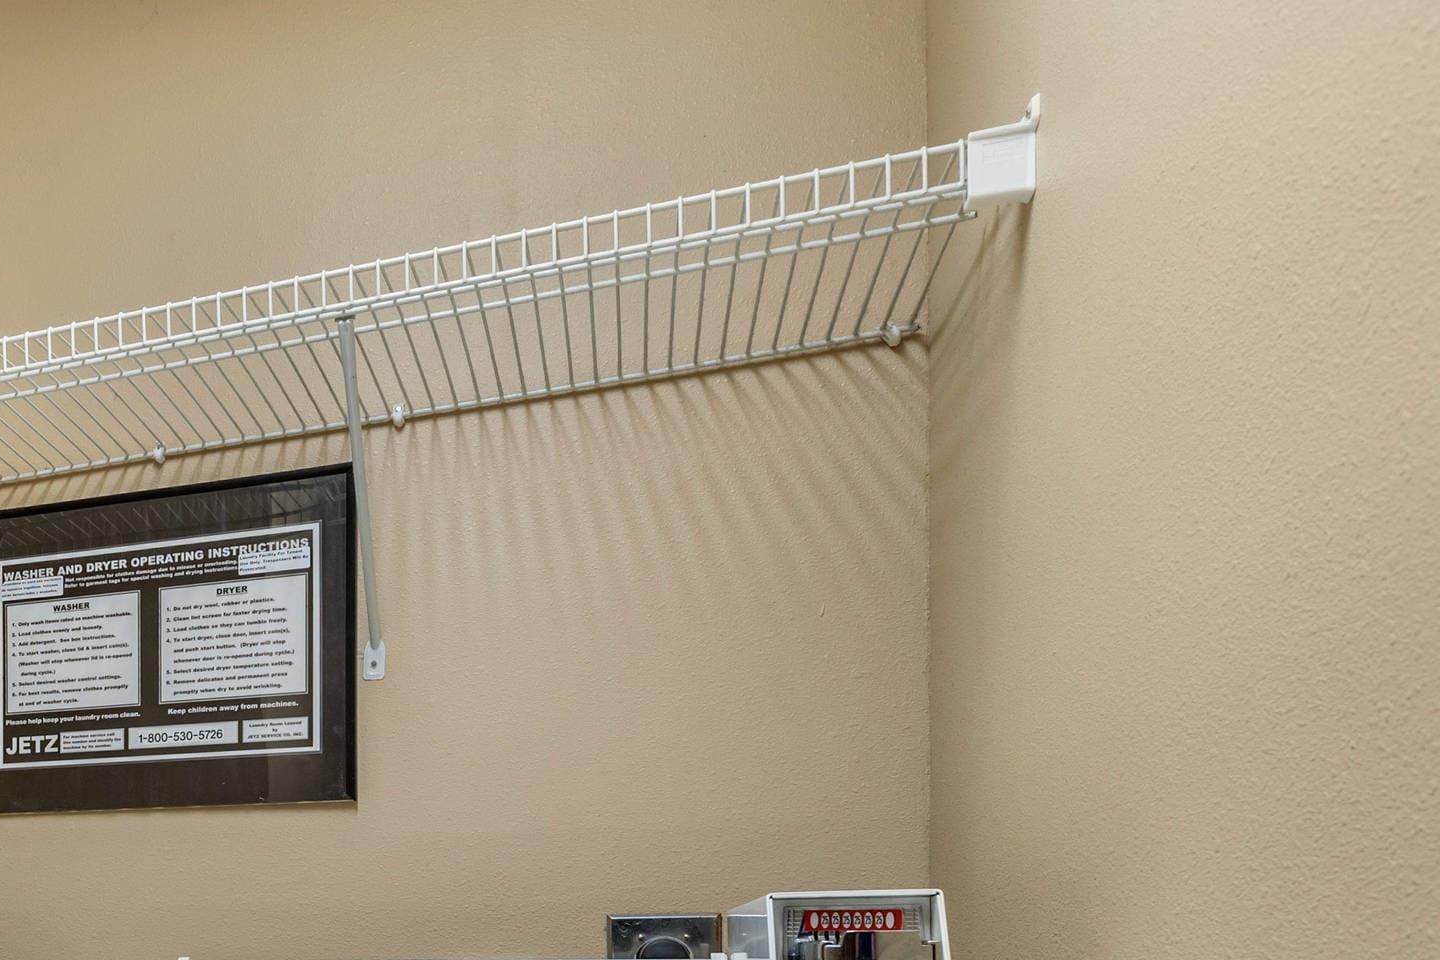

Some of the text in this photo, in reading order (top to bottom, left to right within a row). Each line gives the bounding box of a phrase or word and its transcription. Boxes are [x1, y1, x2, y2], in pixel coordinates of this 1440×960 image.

[3, 537, 309, 582] WASHER AND DRYER OPERATING INSTRUCTIONS
[216, 585, 247, 595] DRYER
[52, 601, 89, 612] WASHER
[259, 700, 299, 708] machines.
[138, 728, 223, 743] 1-800-530-5726
[5, 734, 58, 755] JETZ
